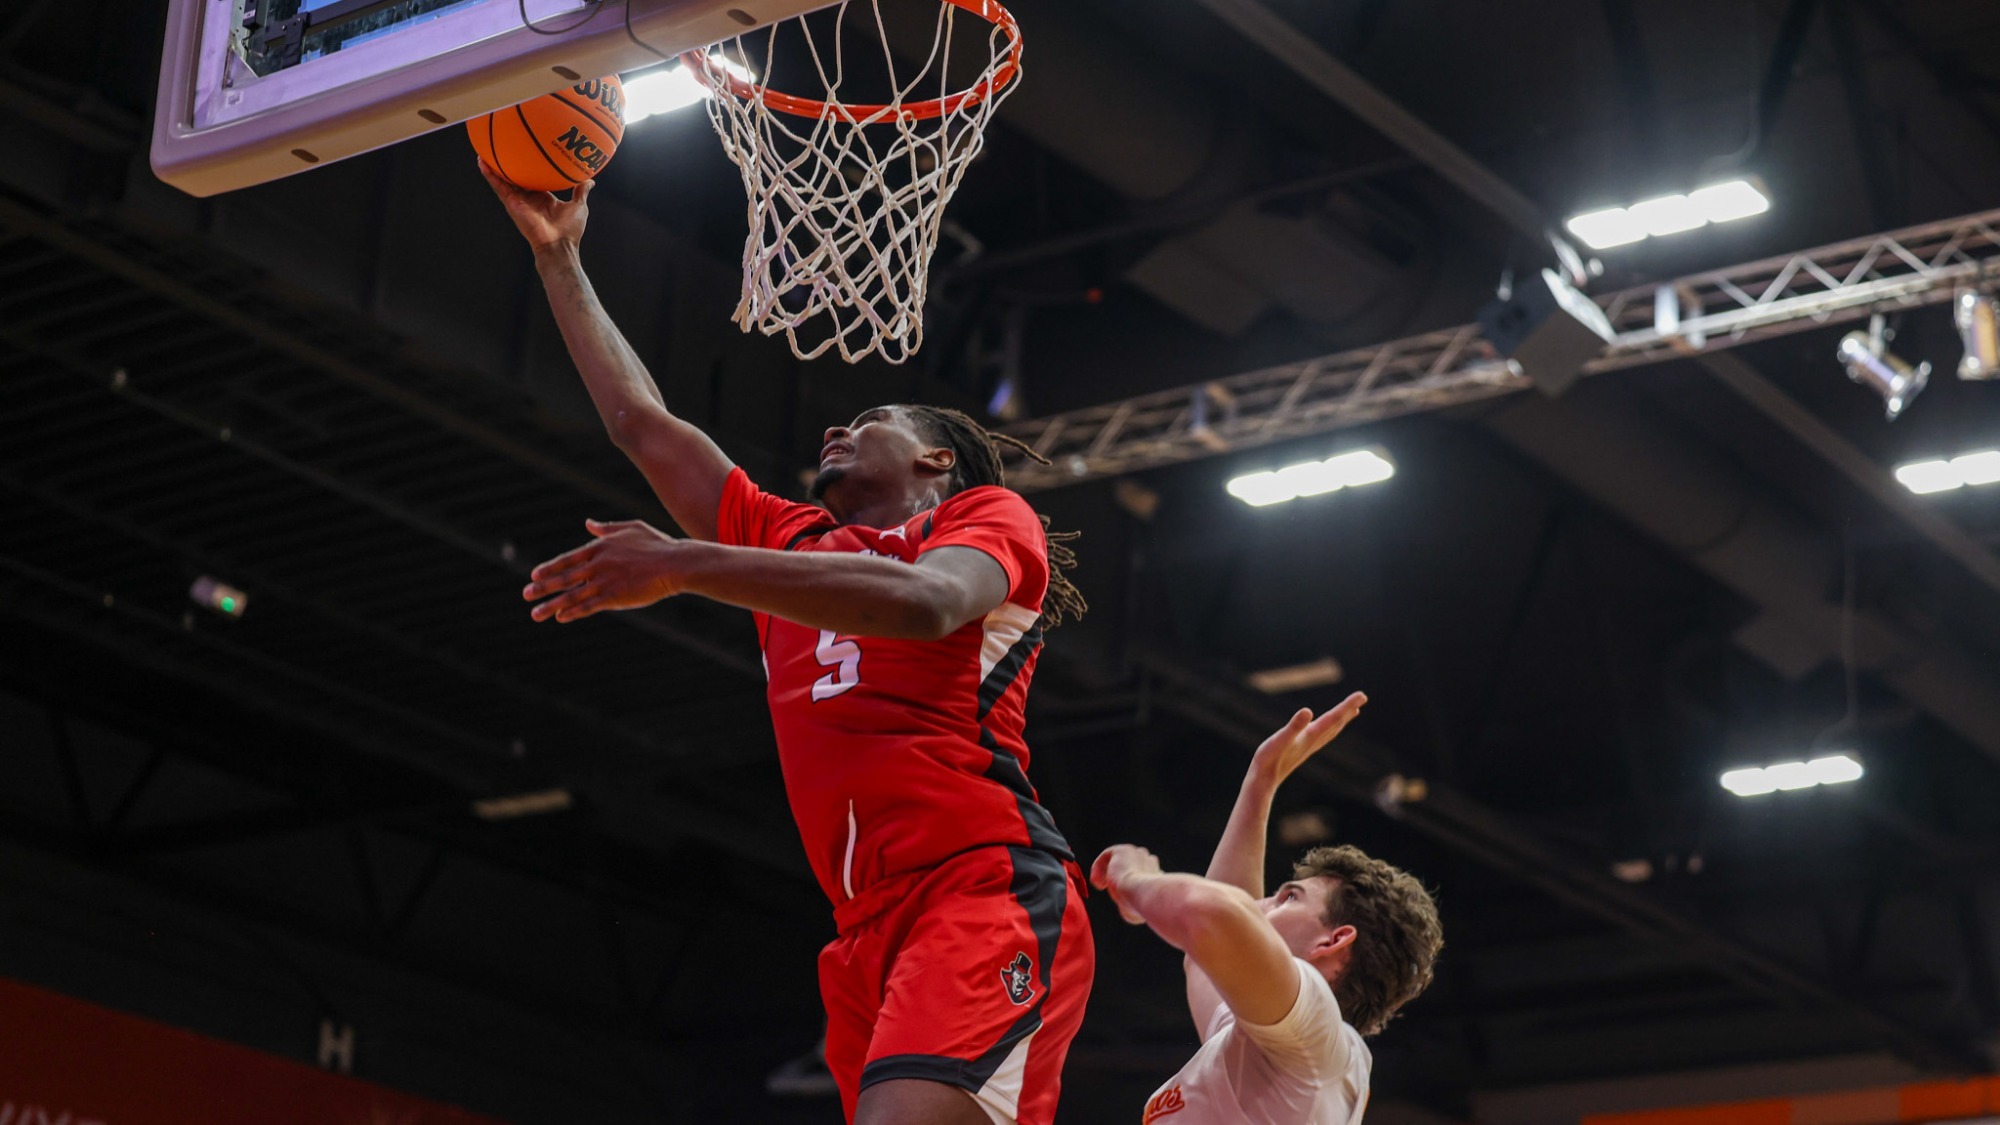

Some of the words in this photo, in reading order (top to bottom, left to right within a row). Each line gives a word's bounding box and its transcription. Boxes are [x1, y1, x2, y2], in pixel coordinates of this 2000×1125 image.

[557, 125, 609, 172] NCAA
[811, 629, 862, 703] 5
[317, 1017, 354, 1073] H
